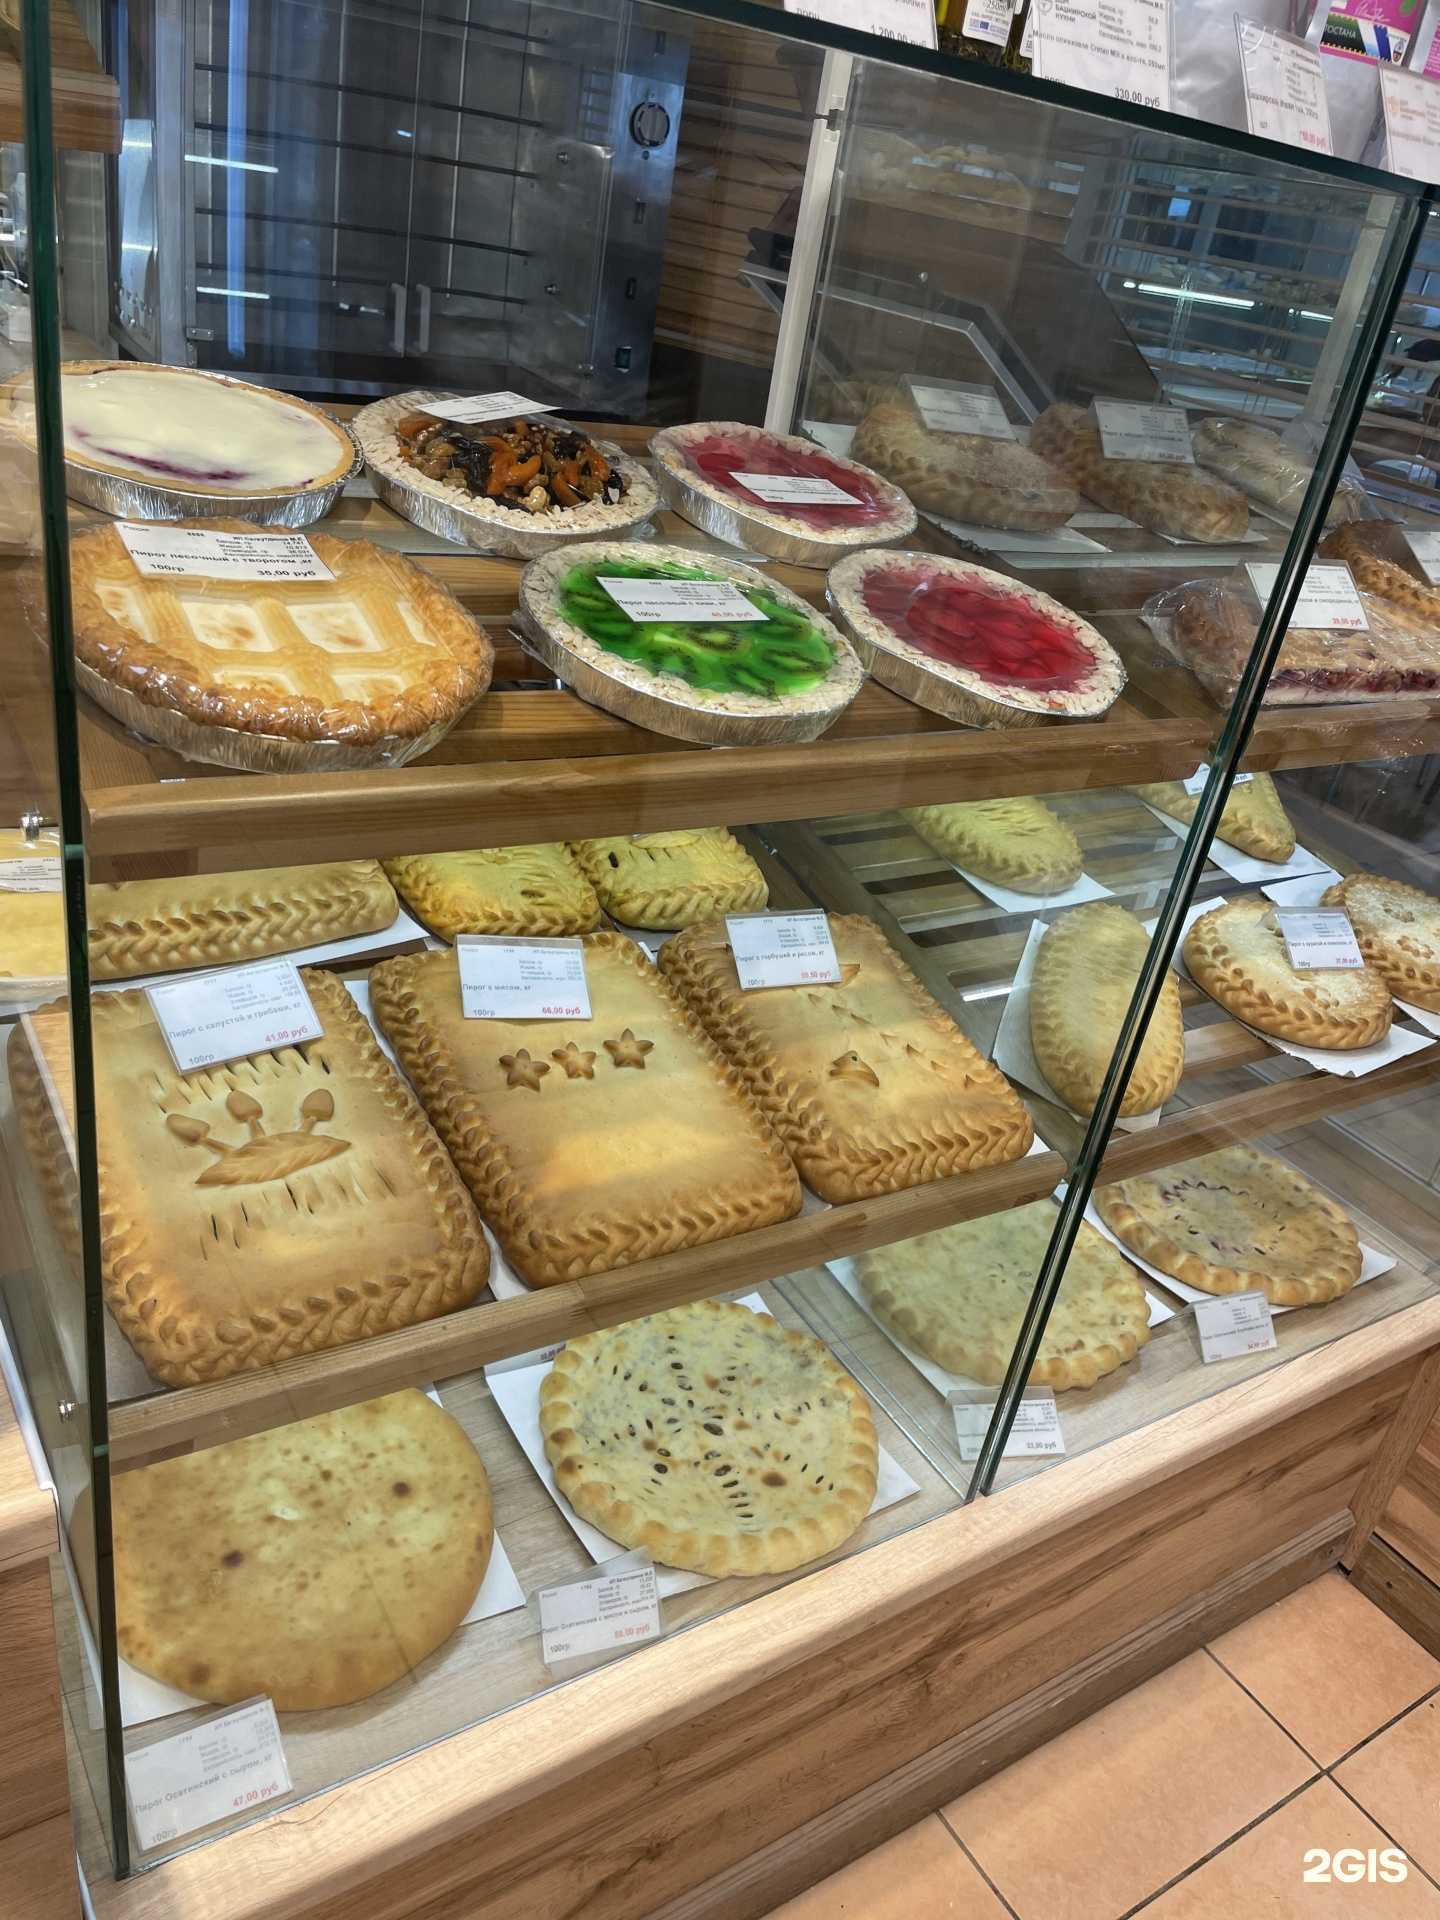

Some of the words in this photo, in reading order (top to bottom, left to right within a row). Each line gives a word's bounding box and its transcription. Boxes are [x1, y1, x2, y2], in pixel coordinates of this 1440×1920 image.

[1114, 87, 1142, 103] 330,00
[1144, 95, 1161, 108] руб
[130, 549, 166, 558] Пирог
[169, 552, 229, 563] песочный
[243, 557, 297, 566] творогом
[150, 563, 185, 573] 100гр
[293, 569, 316, 579] руб
[462, 983, 486, 992] Пирог
[473, 1008, 496, 1017] 100гр
[565, 1006, 581, 1016] руб
[169, 1026, 196, 1040] Пирог
[205, 1014, 246, 1030] капустой
[254, 1004, 293, 1020] грибами,
[291, 1025, 308, 1039] руб
[188, 1053, 216, 1066] 100гр
[135, 1798, 163, 1814] Пирог
[164, 1775, 221, 1802] Осетинский
[233, 1791, 258, 1808] 47,00
[259, 1780, 280, 1798] руб
